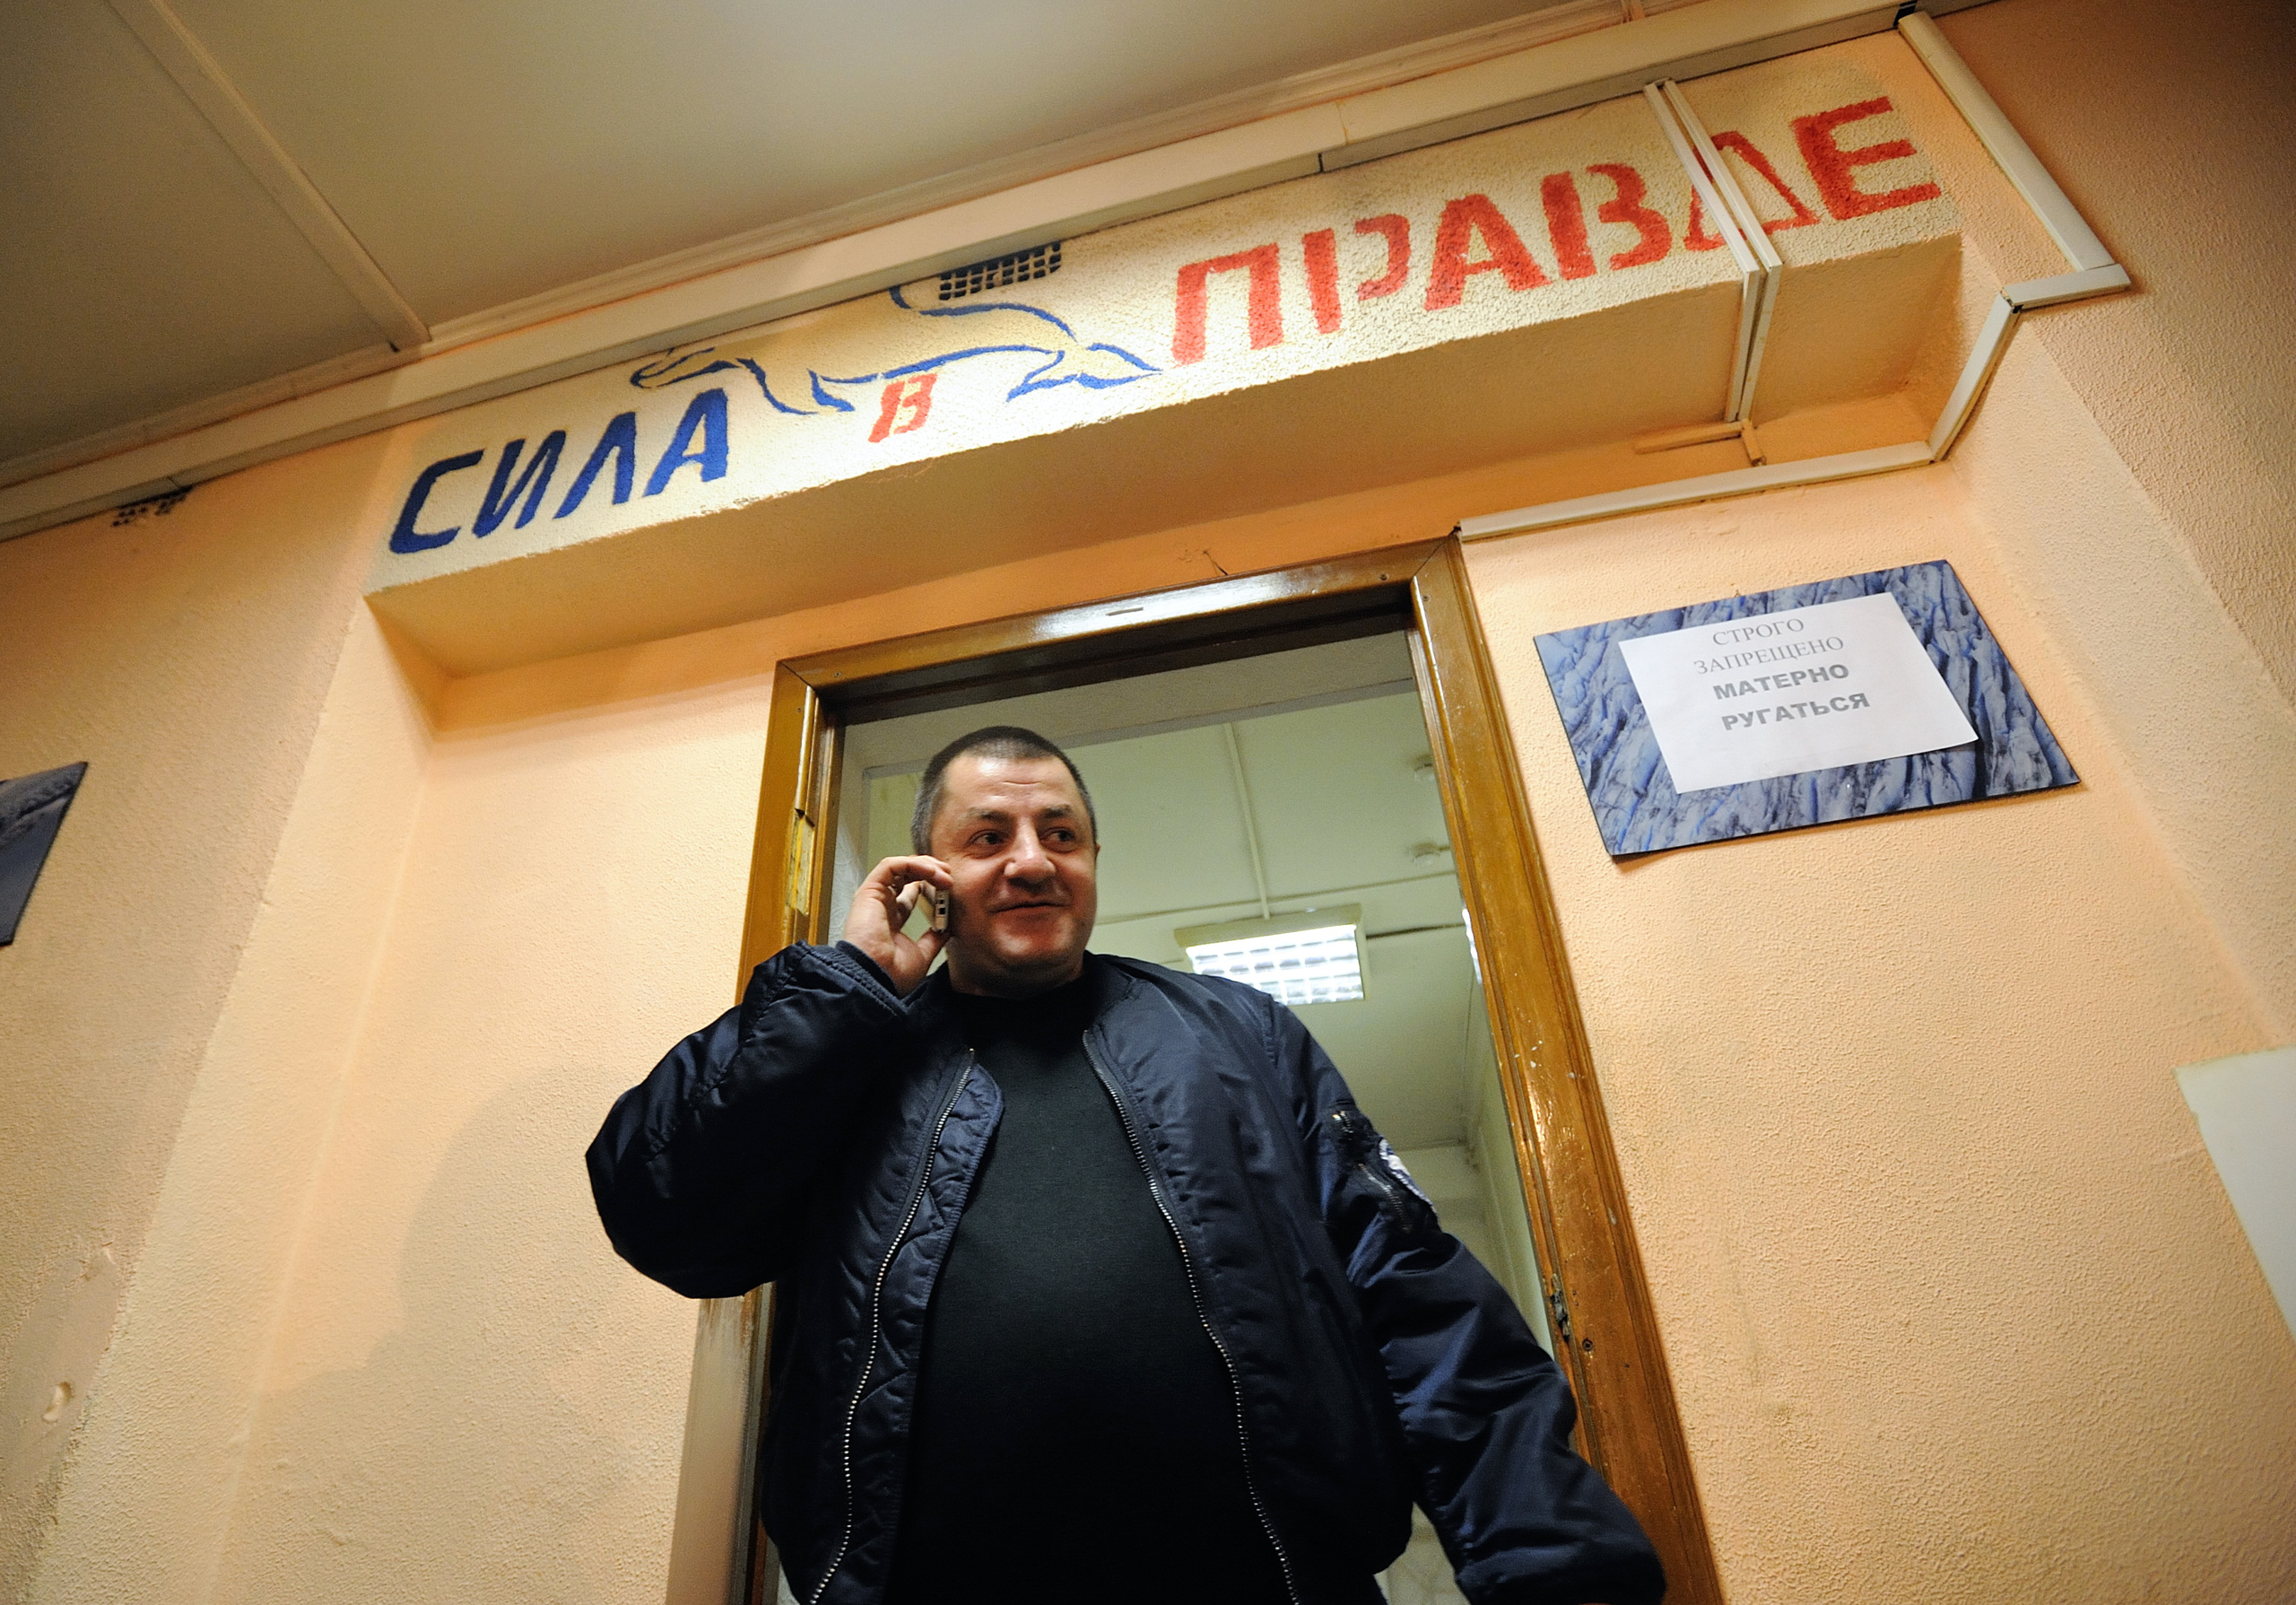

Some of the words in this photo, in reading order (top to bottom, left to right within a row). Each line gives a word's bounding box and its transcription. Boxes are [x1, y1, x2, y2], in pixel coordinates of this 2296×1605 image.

[389, 387, 728, 554] СИЛА
[868, 372, 938, 443] В
[1171, 95, 1941, 365] ПРАВДЕ
[1711, 617, 1805, 647] СТРОГО
[1693, 635, 1844, 676] ЗАПРЕЩЕНО
[1712, 663, 1850, 700] МАТЕРНО
[1721, 692, 1871, 731] РУГАТЬСЯ
